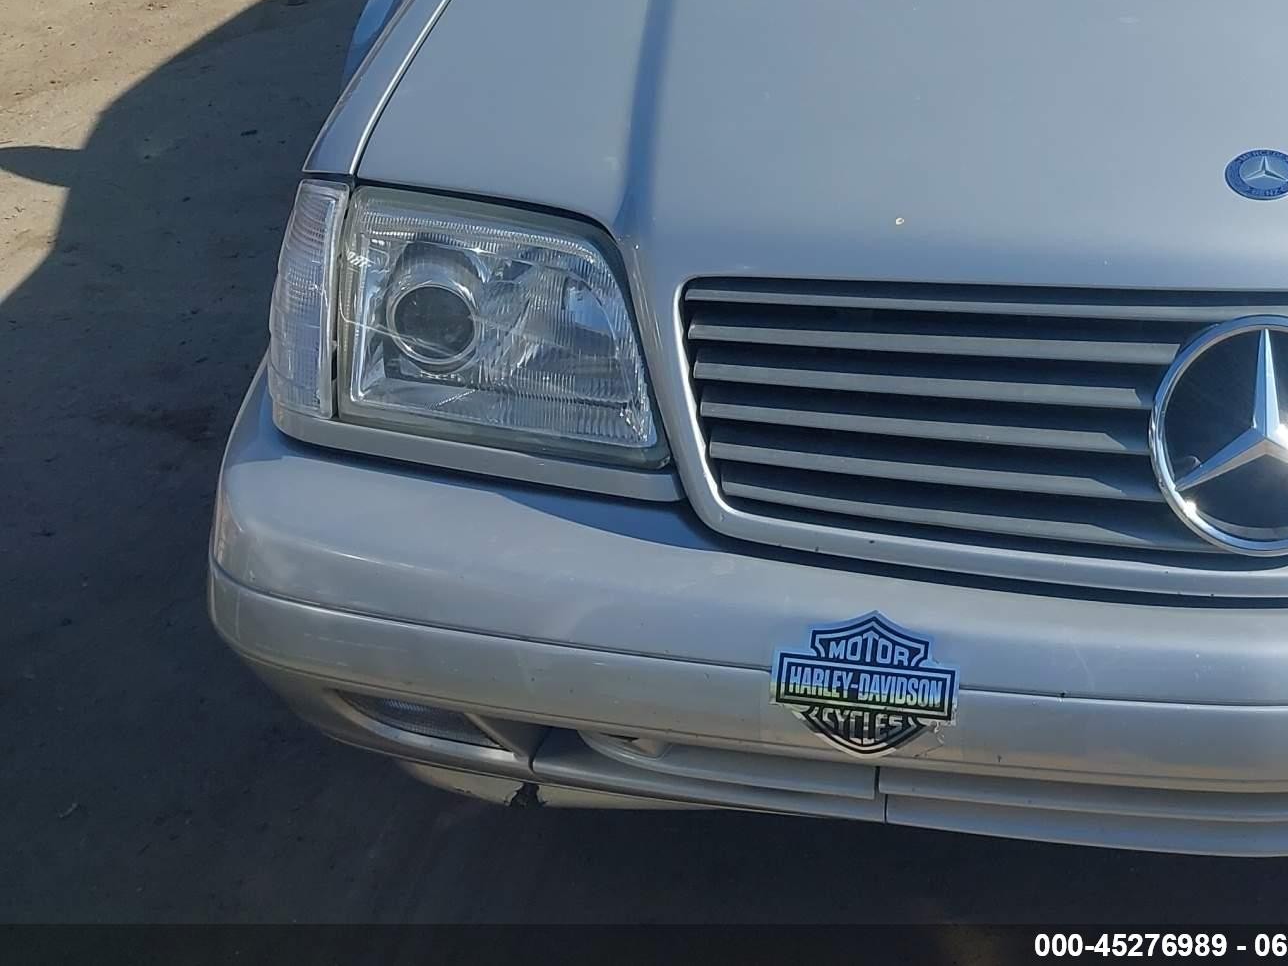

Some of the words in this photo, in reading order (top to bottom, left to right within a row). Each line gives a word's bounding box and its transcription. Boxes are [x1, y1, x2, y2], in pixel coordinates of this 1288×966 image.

[828, 630, 910, 667] MOTOR
[788, 665, 944, 708] HARLEY-DAVIDSON
[821, 707, 904, 743] CYCLES
